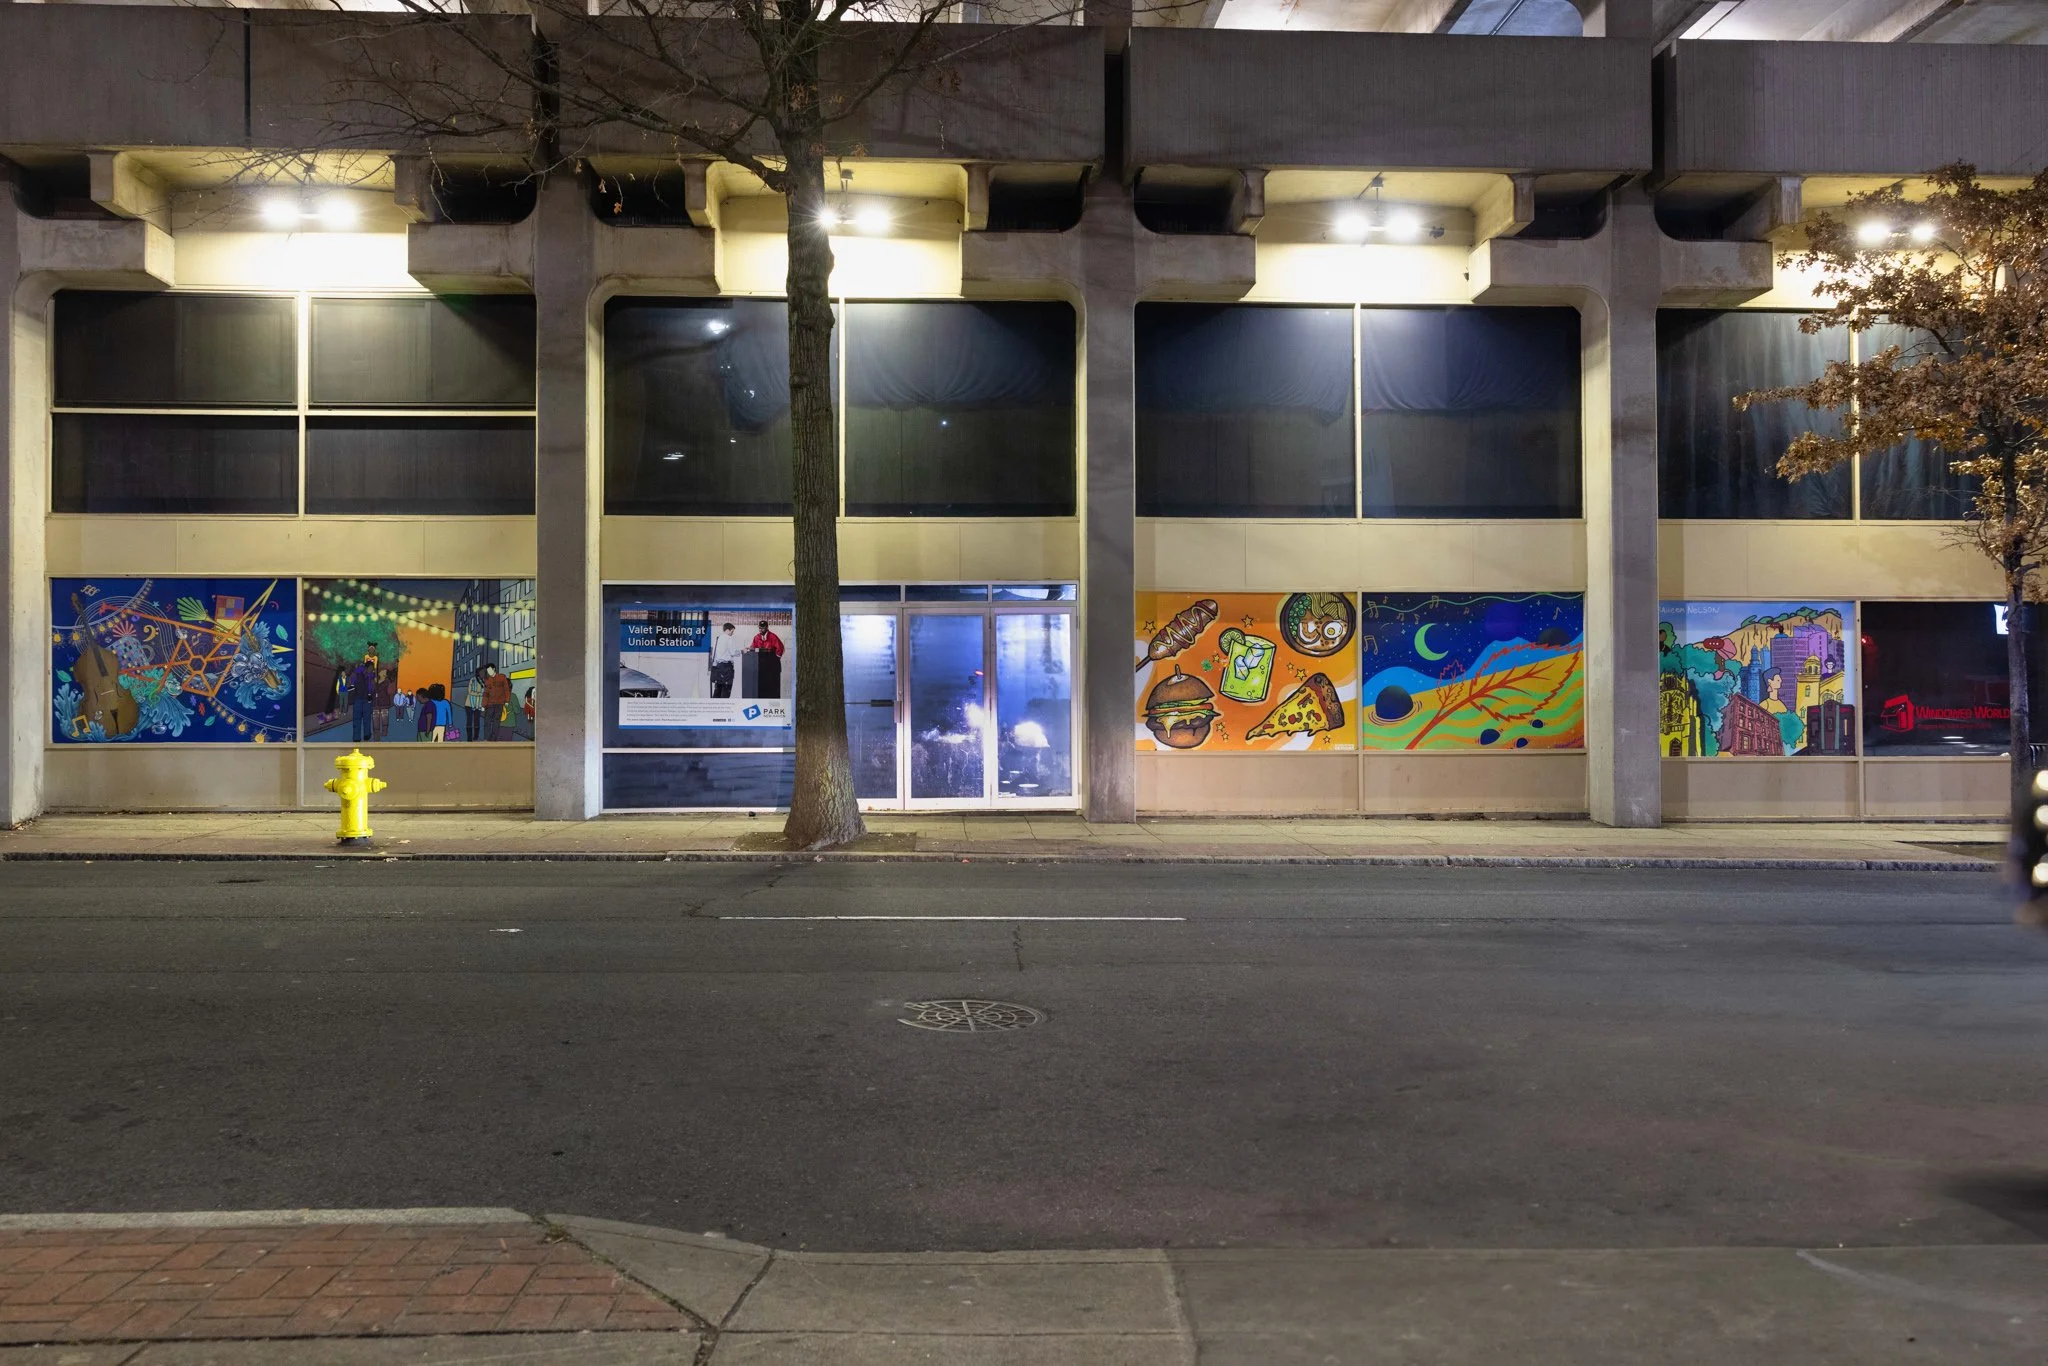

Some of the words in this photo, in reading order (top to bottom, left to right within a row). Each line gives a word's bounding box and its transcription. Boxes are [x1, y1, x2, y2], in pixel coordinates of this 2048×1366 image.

[628, 625, 653, 635] Valet
[656, 625, 693, 637] Parking
[695, 626, 706, 635] at
[628, 637, 656, 646] Union
[659, 637, 694, 647] Station
